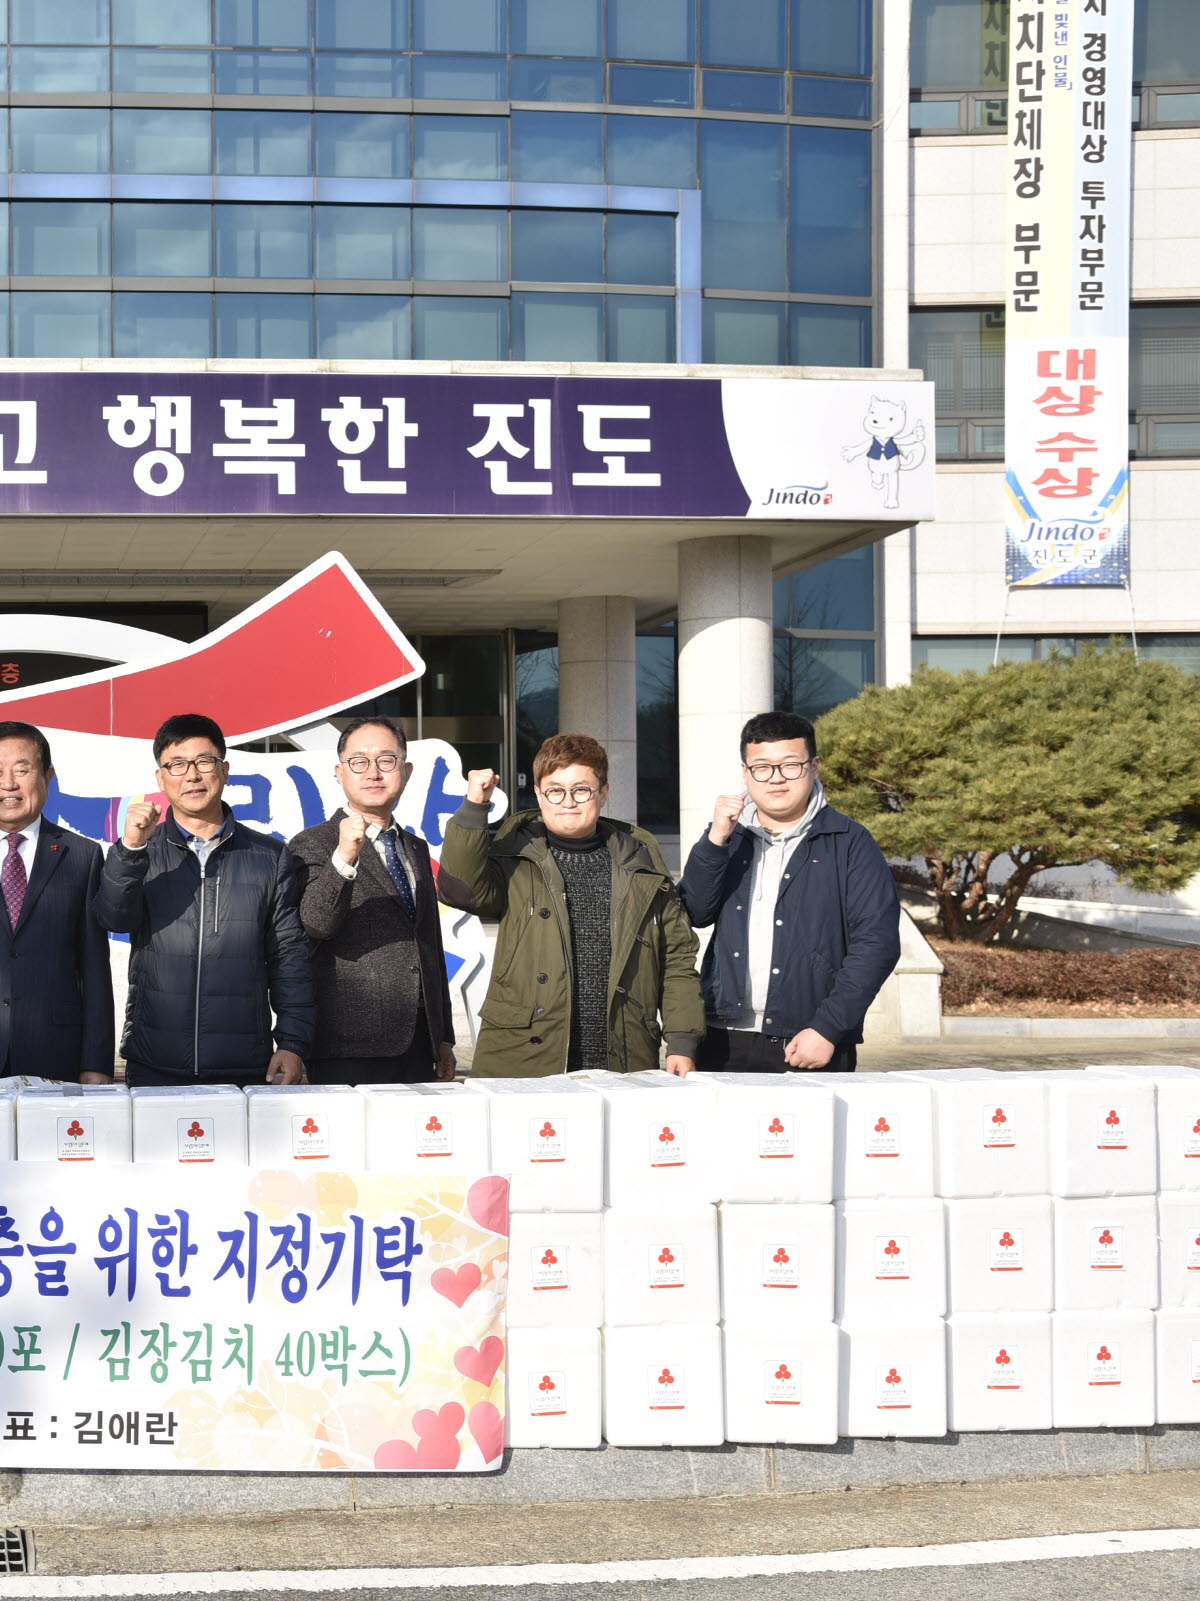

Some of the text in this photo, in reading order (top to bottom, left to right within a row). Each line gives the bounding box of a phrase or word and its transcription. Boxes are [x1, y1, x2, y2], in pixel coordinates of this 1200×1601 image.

[1054, 13, 1068, 46] 빛낸
[1080, 33, 1107, 164] 경영대상
[1013, 0, 1046, 312] 치단체장 부문
[1078, 181, 1106, 310] 투자부문
[102, 394, 418, 497] 행복한
[466, 397, 662, 495] 진도
[1031, 348, 1103, 499] 대상 수상
[761, 488, 821, 505] Jindo
[1020, 521, 1095, 543] Jindo
[93, 1207, 199, 1302] 위한
[213, 1209, 424, 1307] 지정기탁
[62, 1322, 81, 1381] /
[99, 1320, 256, 1385] 김장김치
[275, 1325, 412, 1387] 40박스)
[73, 1410, 179, 1445] 김애란
